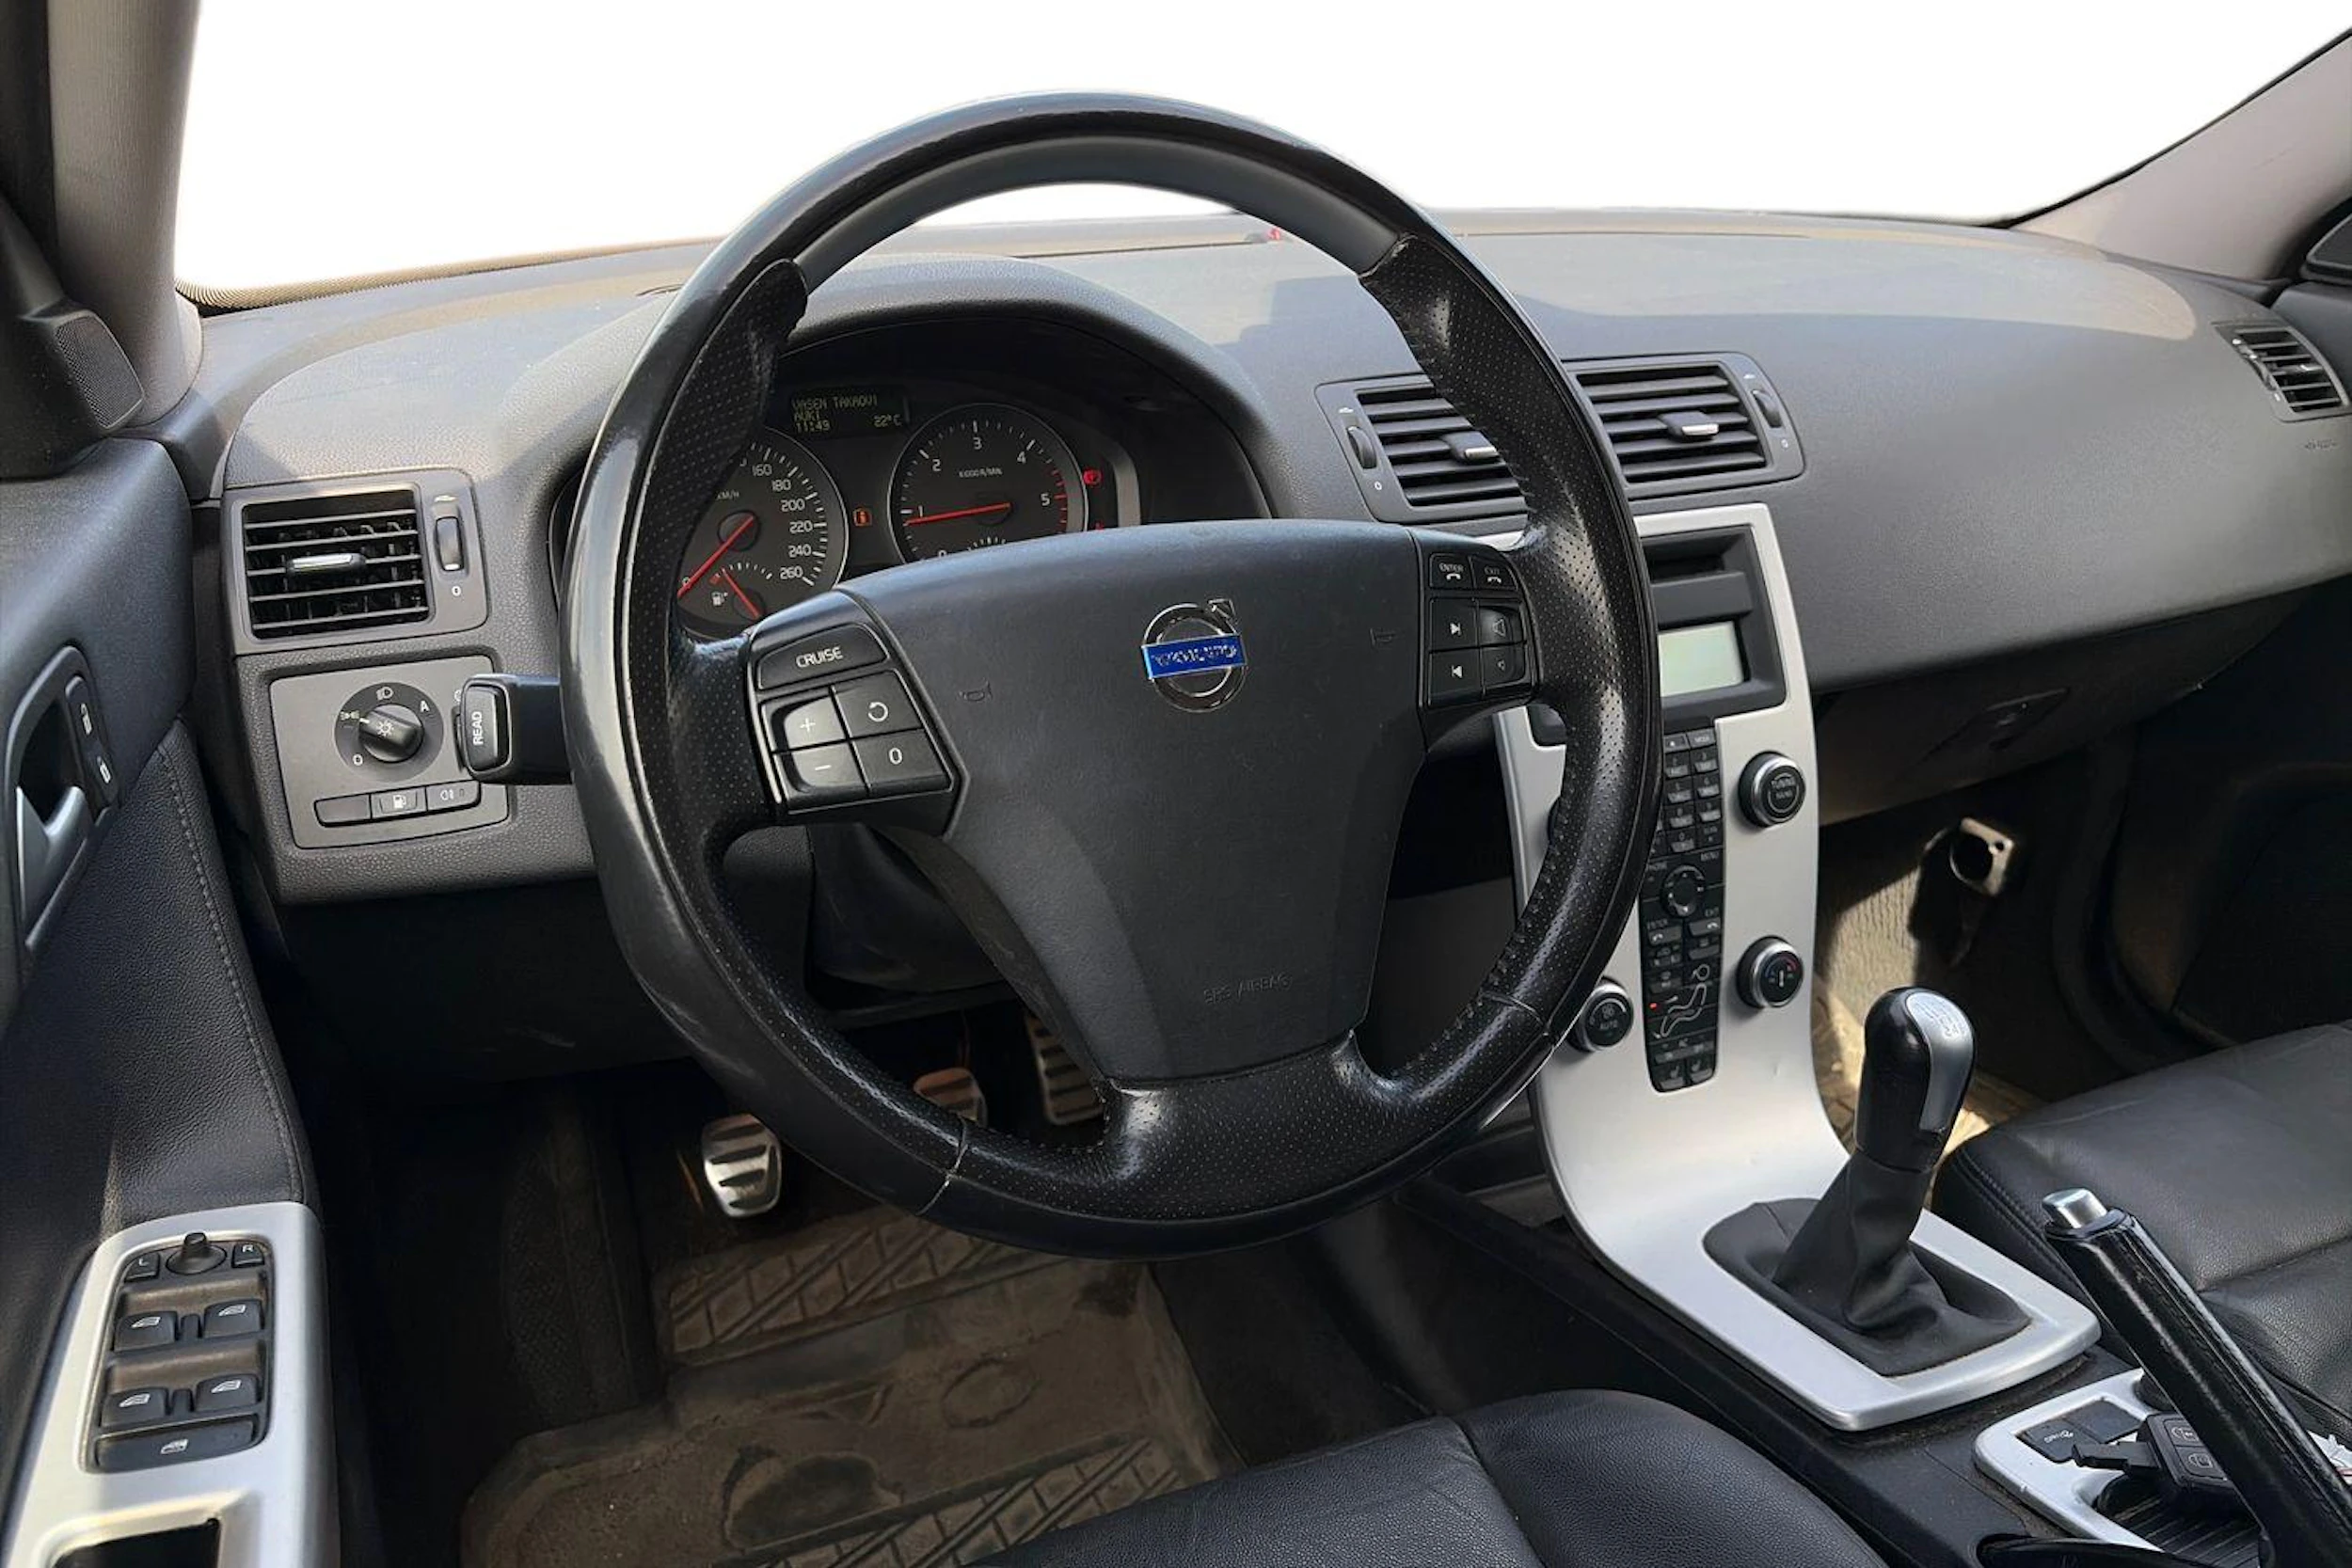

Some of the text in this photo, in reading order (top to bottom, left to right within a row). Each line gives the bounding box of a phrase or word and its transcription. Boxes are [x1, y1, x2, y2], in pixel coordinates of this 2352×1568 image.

[974, 436, 982, 450] 3
[1017, 451, 1026, 464] 4
[752, 464, 772, 476] 160
[931, 458, 941, 471] 2
[771, 479, 791, 491] 180
[780, 499, 805, 512] 200
[1041, 493, 1051, 506] 5
[789, 520, 813, 533] 220
[788, 544, 812, 558] 240
[780, 566, 803, 579] 260
[796, 646, 843, 668] CRUISE
[420, 701, 430, 712] A
[472, 711, 484, 746] READ
[888, 747, 903, 765] 0
[242, 1243, 254, 1253] R
